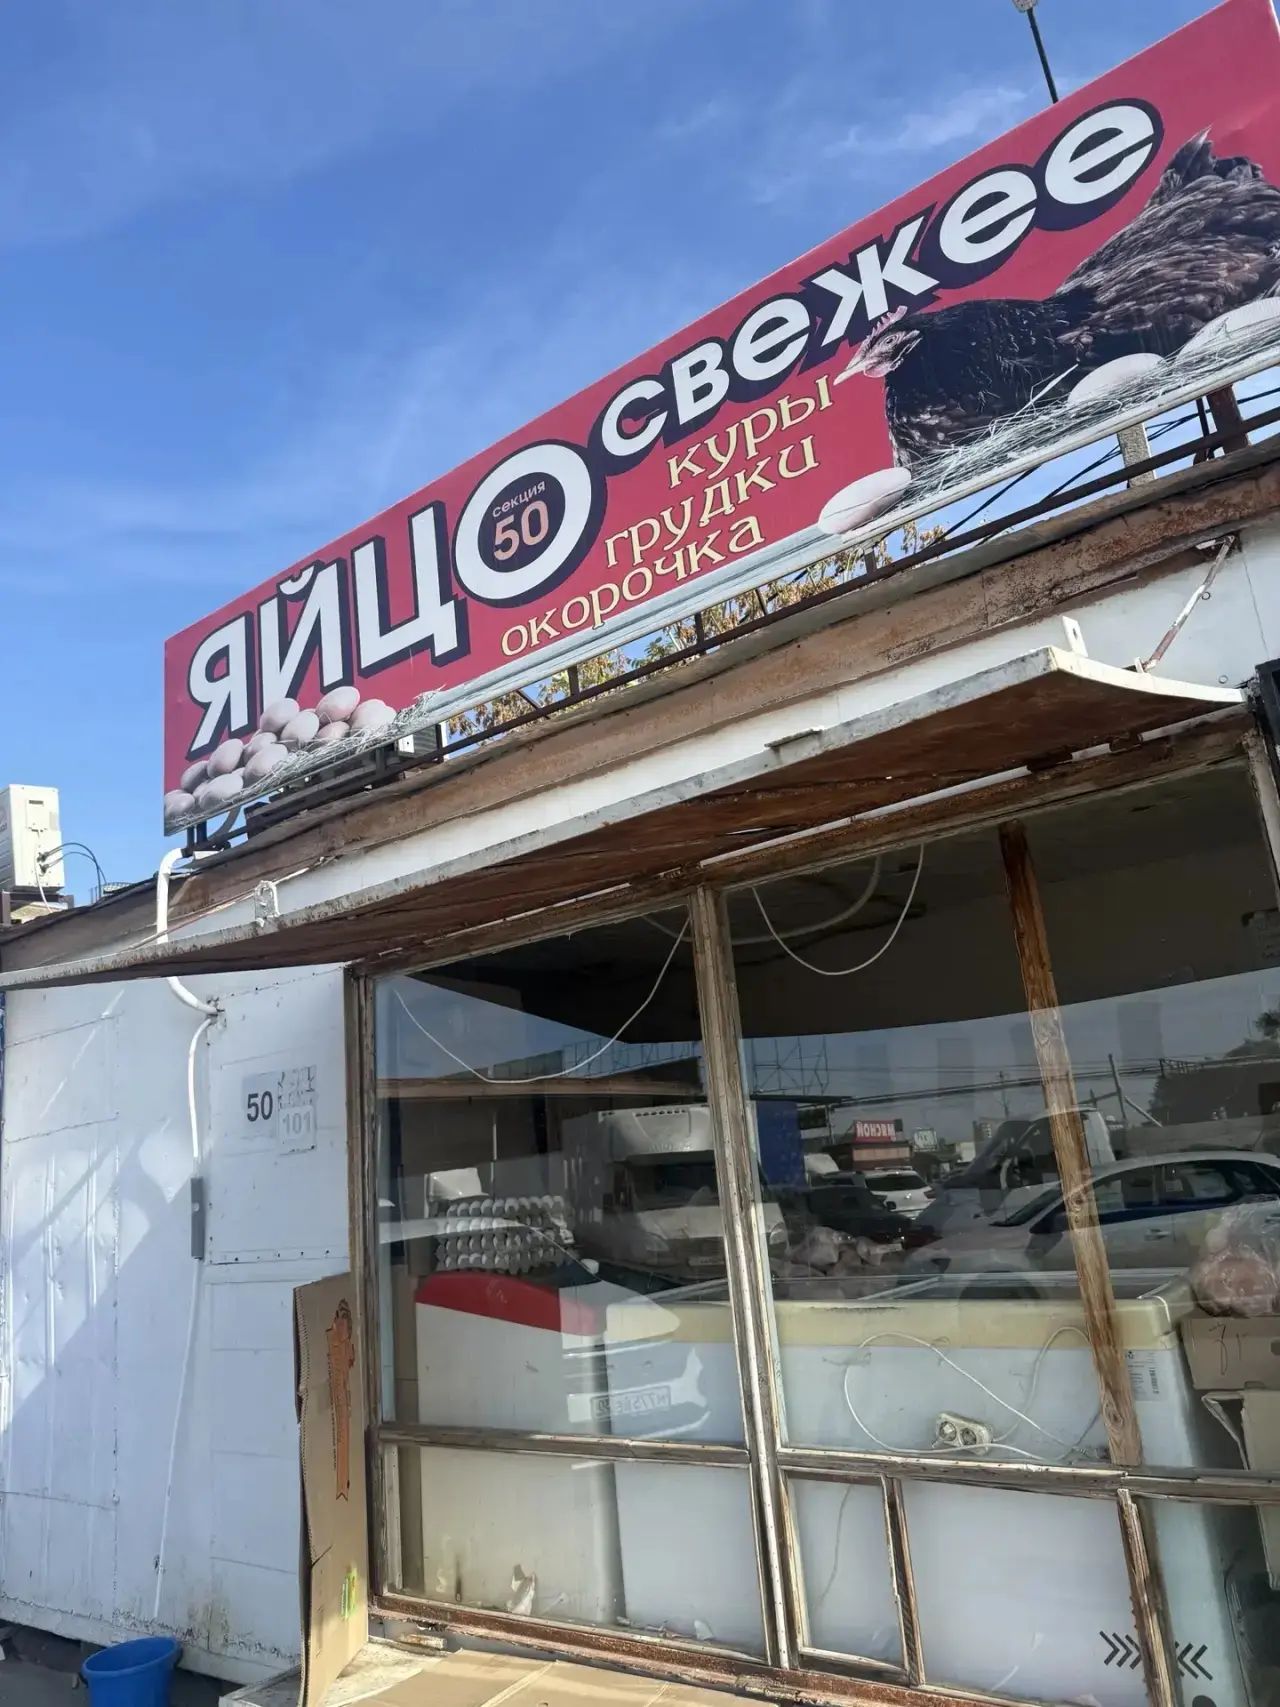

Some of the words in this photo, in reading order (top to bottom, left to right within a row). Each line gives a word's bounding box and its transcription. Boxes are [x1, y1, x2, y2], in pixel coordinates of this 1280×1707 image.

[187, 441, 594, 757] ЯЙЦО
[600, 103, 1155, 458] свежее
[667, 374, 834, 490] куры
[491, 480, 547, 518] секция
[493, 500, 550, 561] 50
[604, 434, 820, 569] грудки
[500, 514, 766, 657] окорочка
[246, 1090, 274, 1123] 50
[282, 1111, 311, 1137] 101
